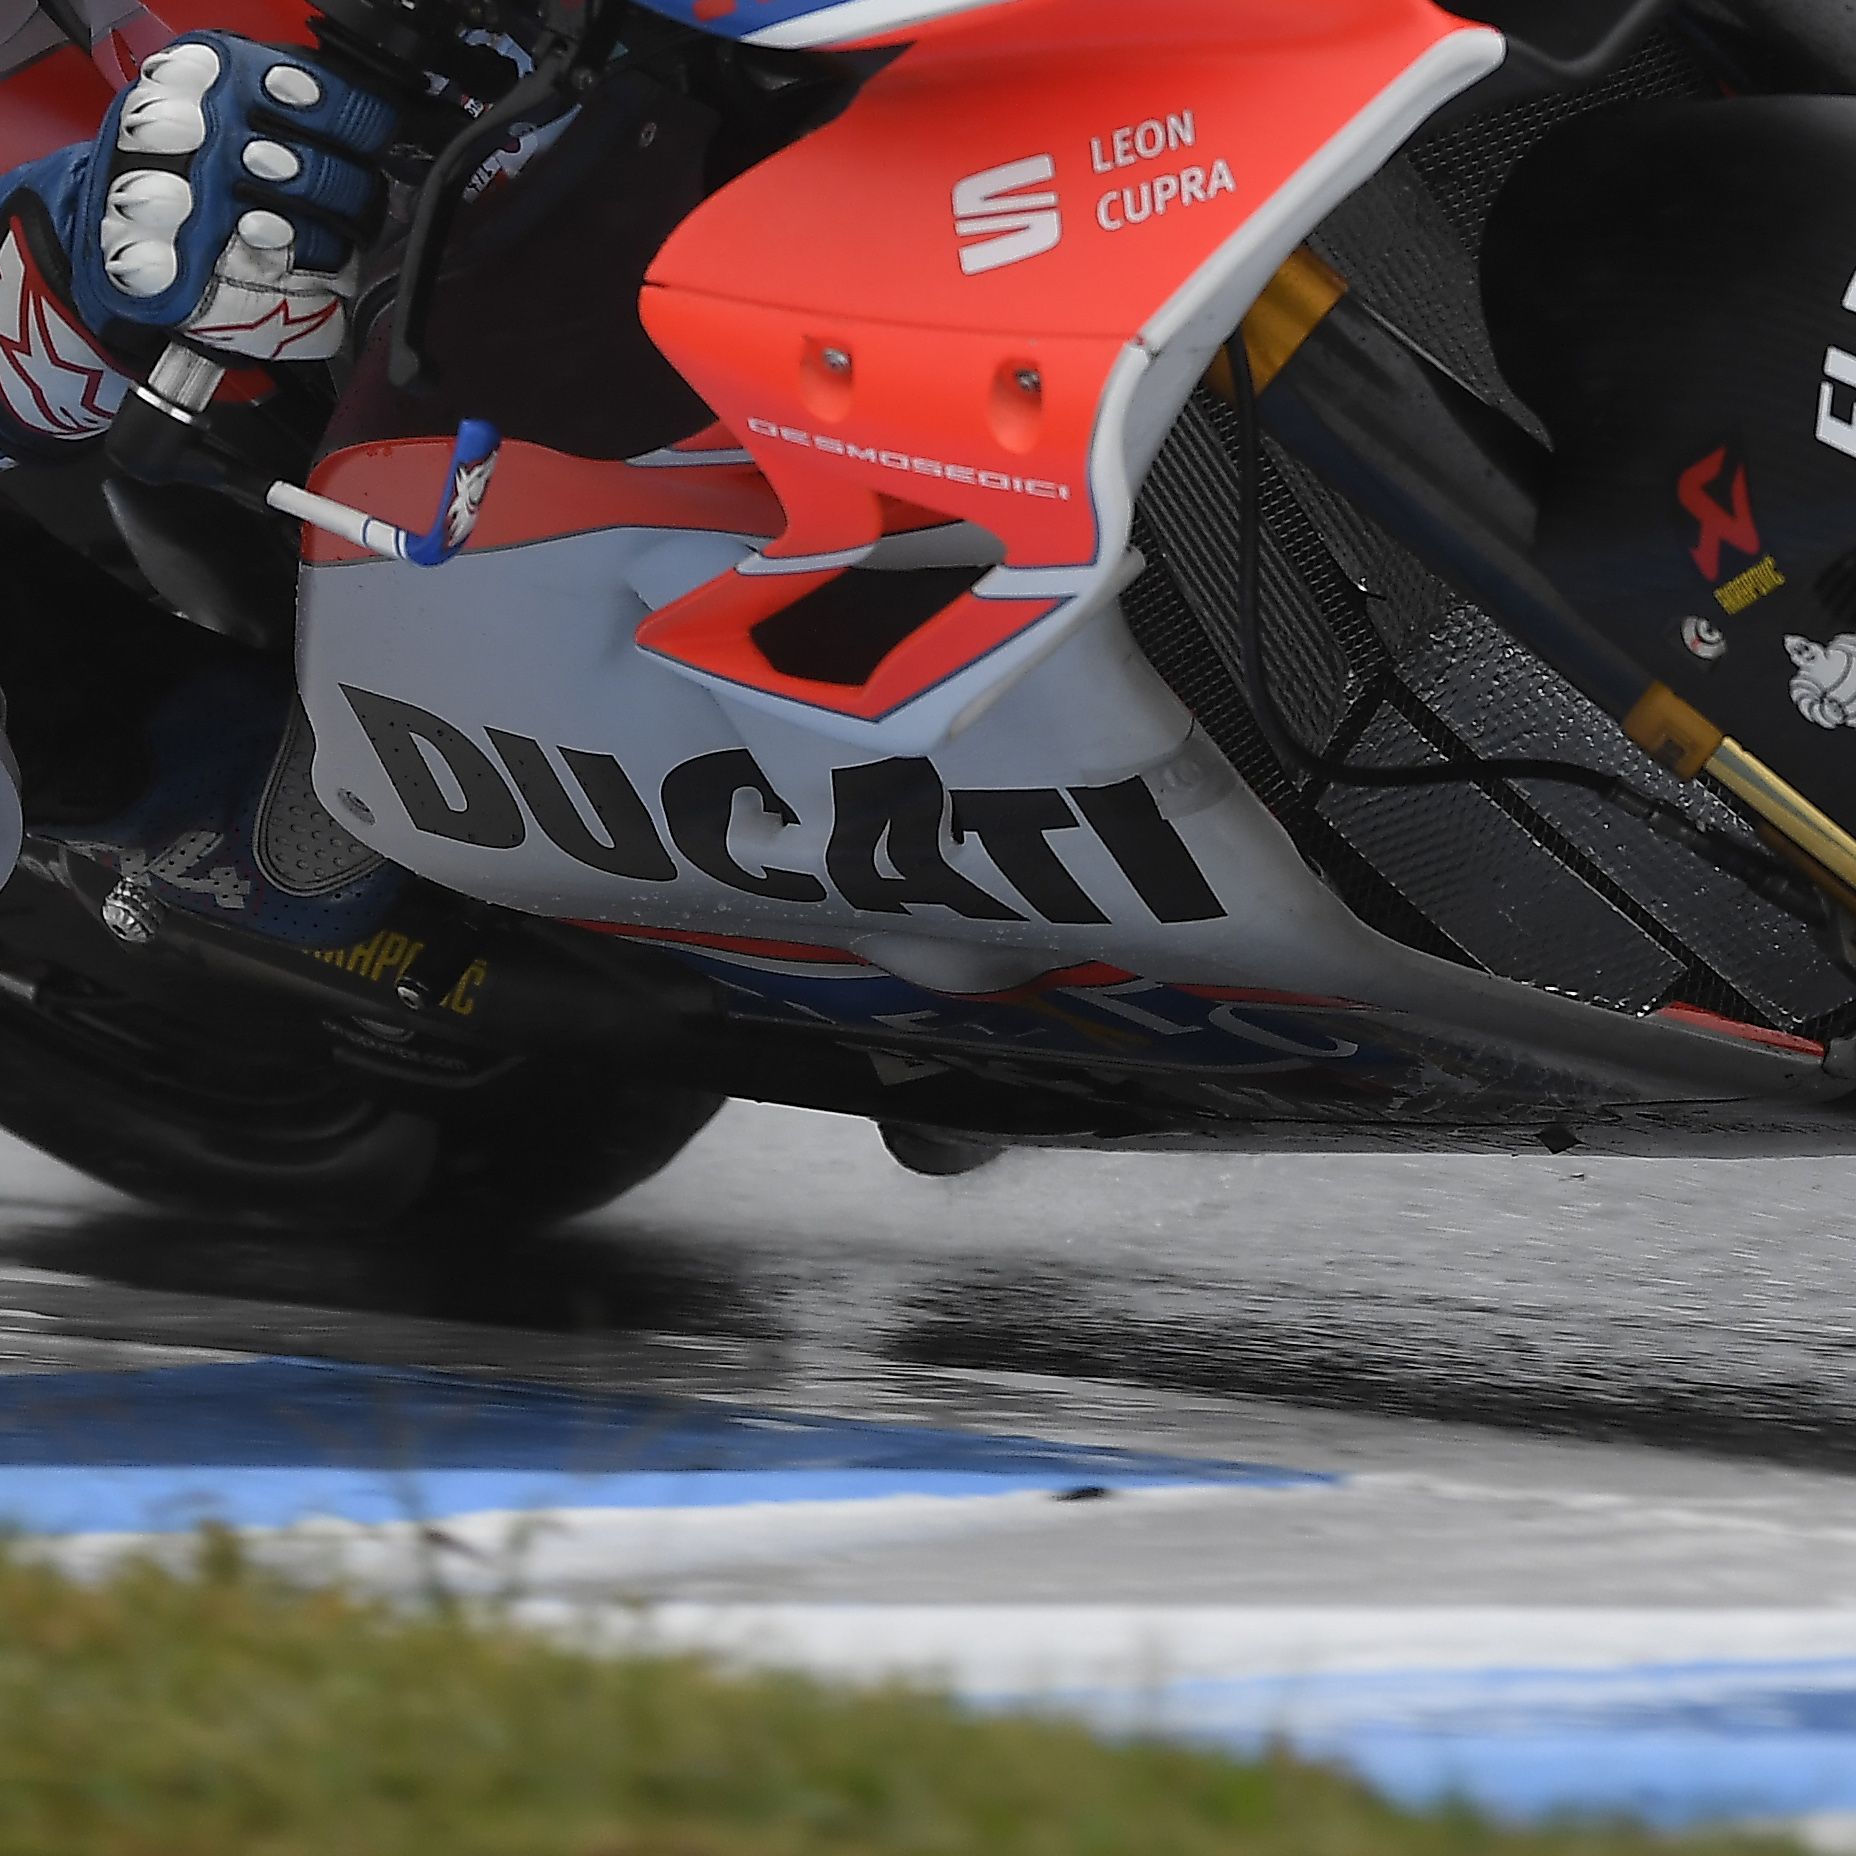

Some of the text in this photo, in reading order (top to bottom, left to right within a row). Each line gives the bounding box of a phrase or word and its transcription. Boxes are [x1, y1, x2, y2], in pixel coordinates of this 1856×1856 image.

[1089, 108, 1199, 176] LEON
[1095, 157, 1239, 232] CUPRA
[745, 415, 1072, 502] DESMOSEDICI
[337, 681, 1228, 926] DUCATI
